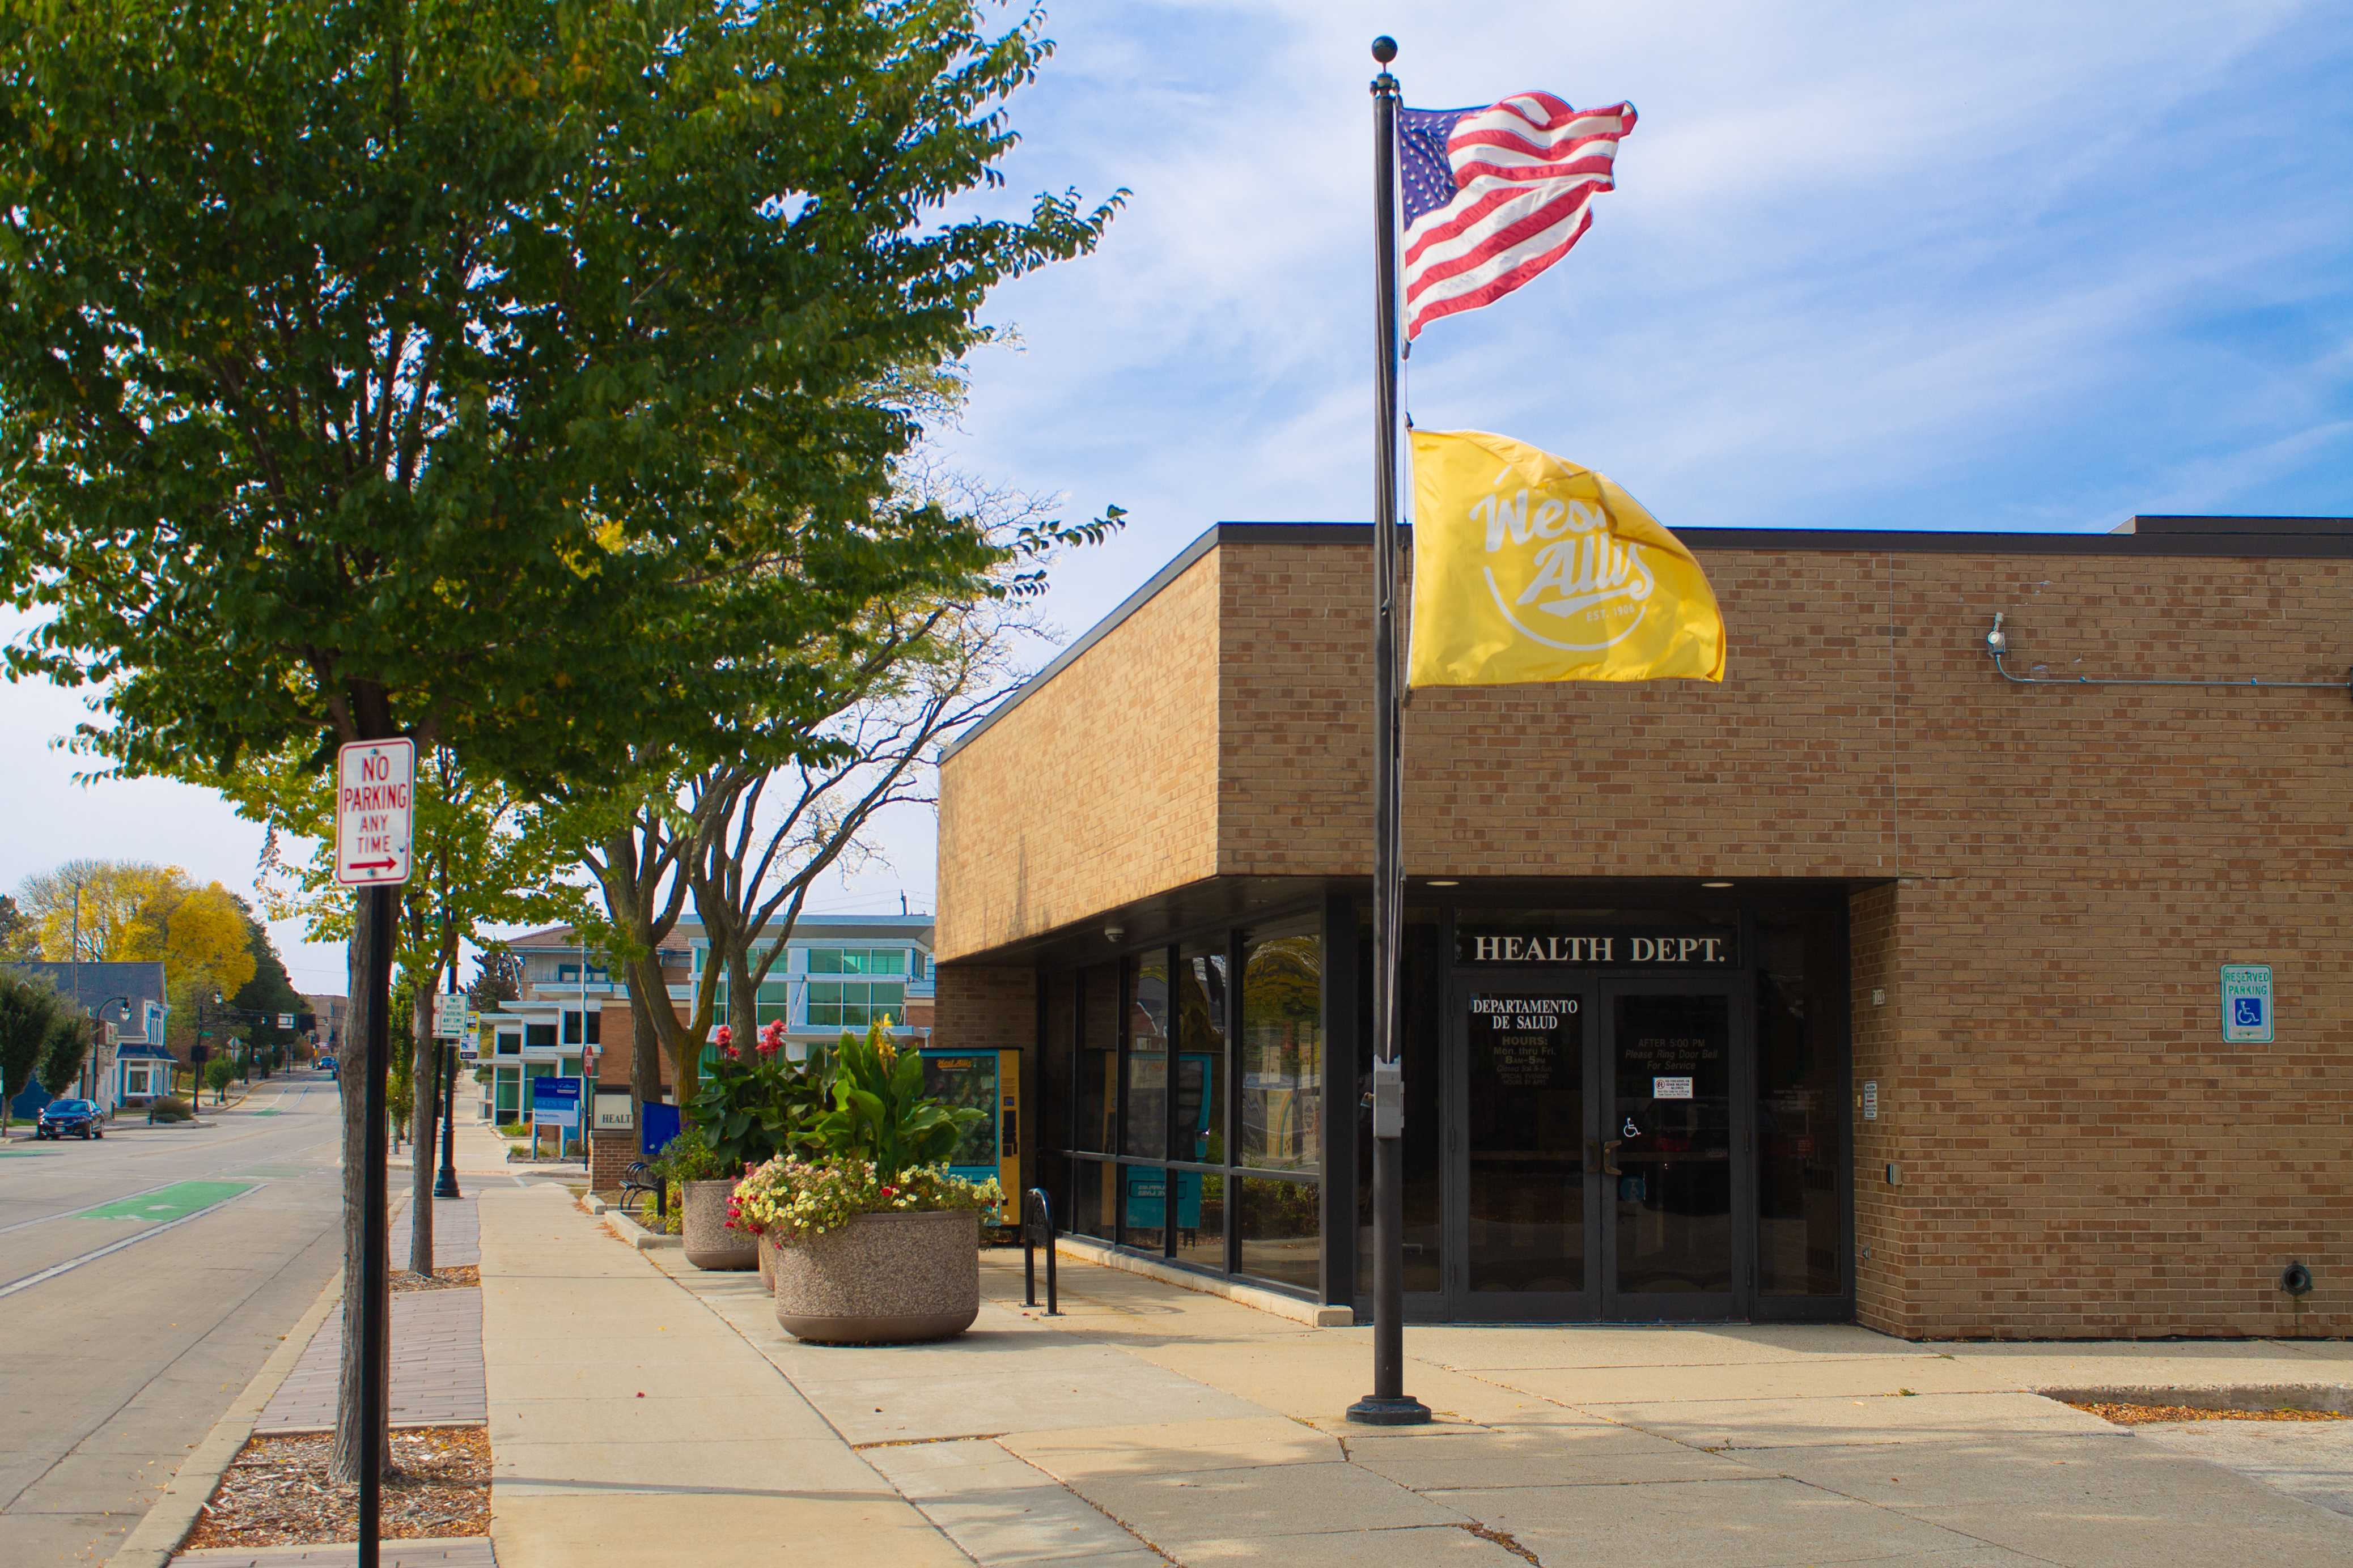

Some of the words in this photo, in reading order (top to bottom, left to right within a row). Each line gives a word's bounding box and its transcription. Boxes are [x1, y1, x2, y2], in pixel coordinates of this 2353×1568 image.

[1587, 609, 1609, 622] EST.
[1613, 603, 1635, 617] 1906
[362, 757, 389, 782] NO
[344, 784, 407, 812] PARKING
[359, 814, 388, 832] ANY
[357, 836, 391, 853] TIME
[1474, 937, 1614, 961] HEALTH
[1630, 938, 1725, 962] DEPT.
[2225, 972, 2269, 982] RESERVED
[2229, 985, 2267, 995] PARKING
[1473, 1000, 1578, 1013] DEPARTAMENTO
[1493, 1015, 1510, 1029] DE
[1517, 1015, 1558, 1029] SALUD
[1502, 1036, 1548, 1046] HOURS:
[1638, 1039, 1666, 1047] AFTER
[1669, 1039, 1689, 1047] 5:00
[1693, 1039, 1705, 1047] PM
[1625, 1049, 1653, 1059] Please
[1657, 1049, 1675, 1060] Ring
[1678, 1049, 1699, 1059] Door
[1702, 1049, 1718, 1059] Bell
[1647, 1060, 1661, 1070] For
[1665, 1060, 1696, 1070] Service
[603, 1114, 633, 1123] HEALT
